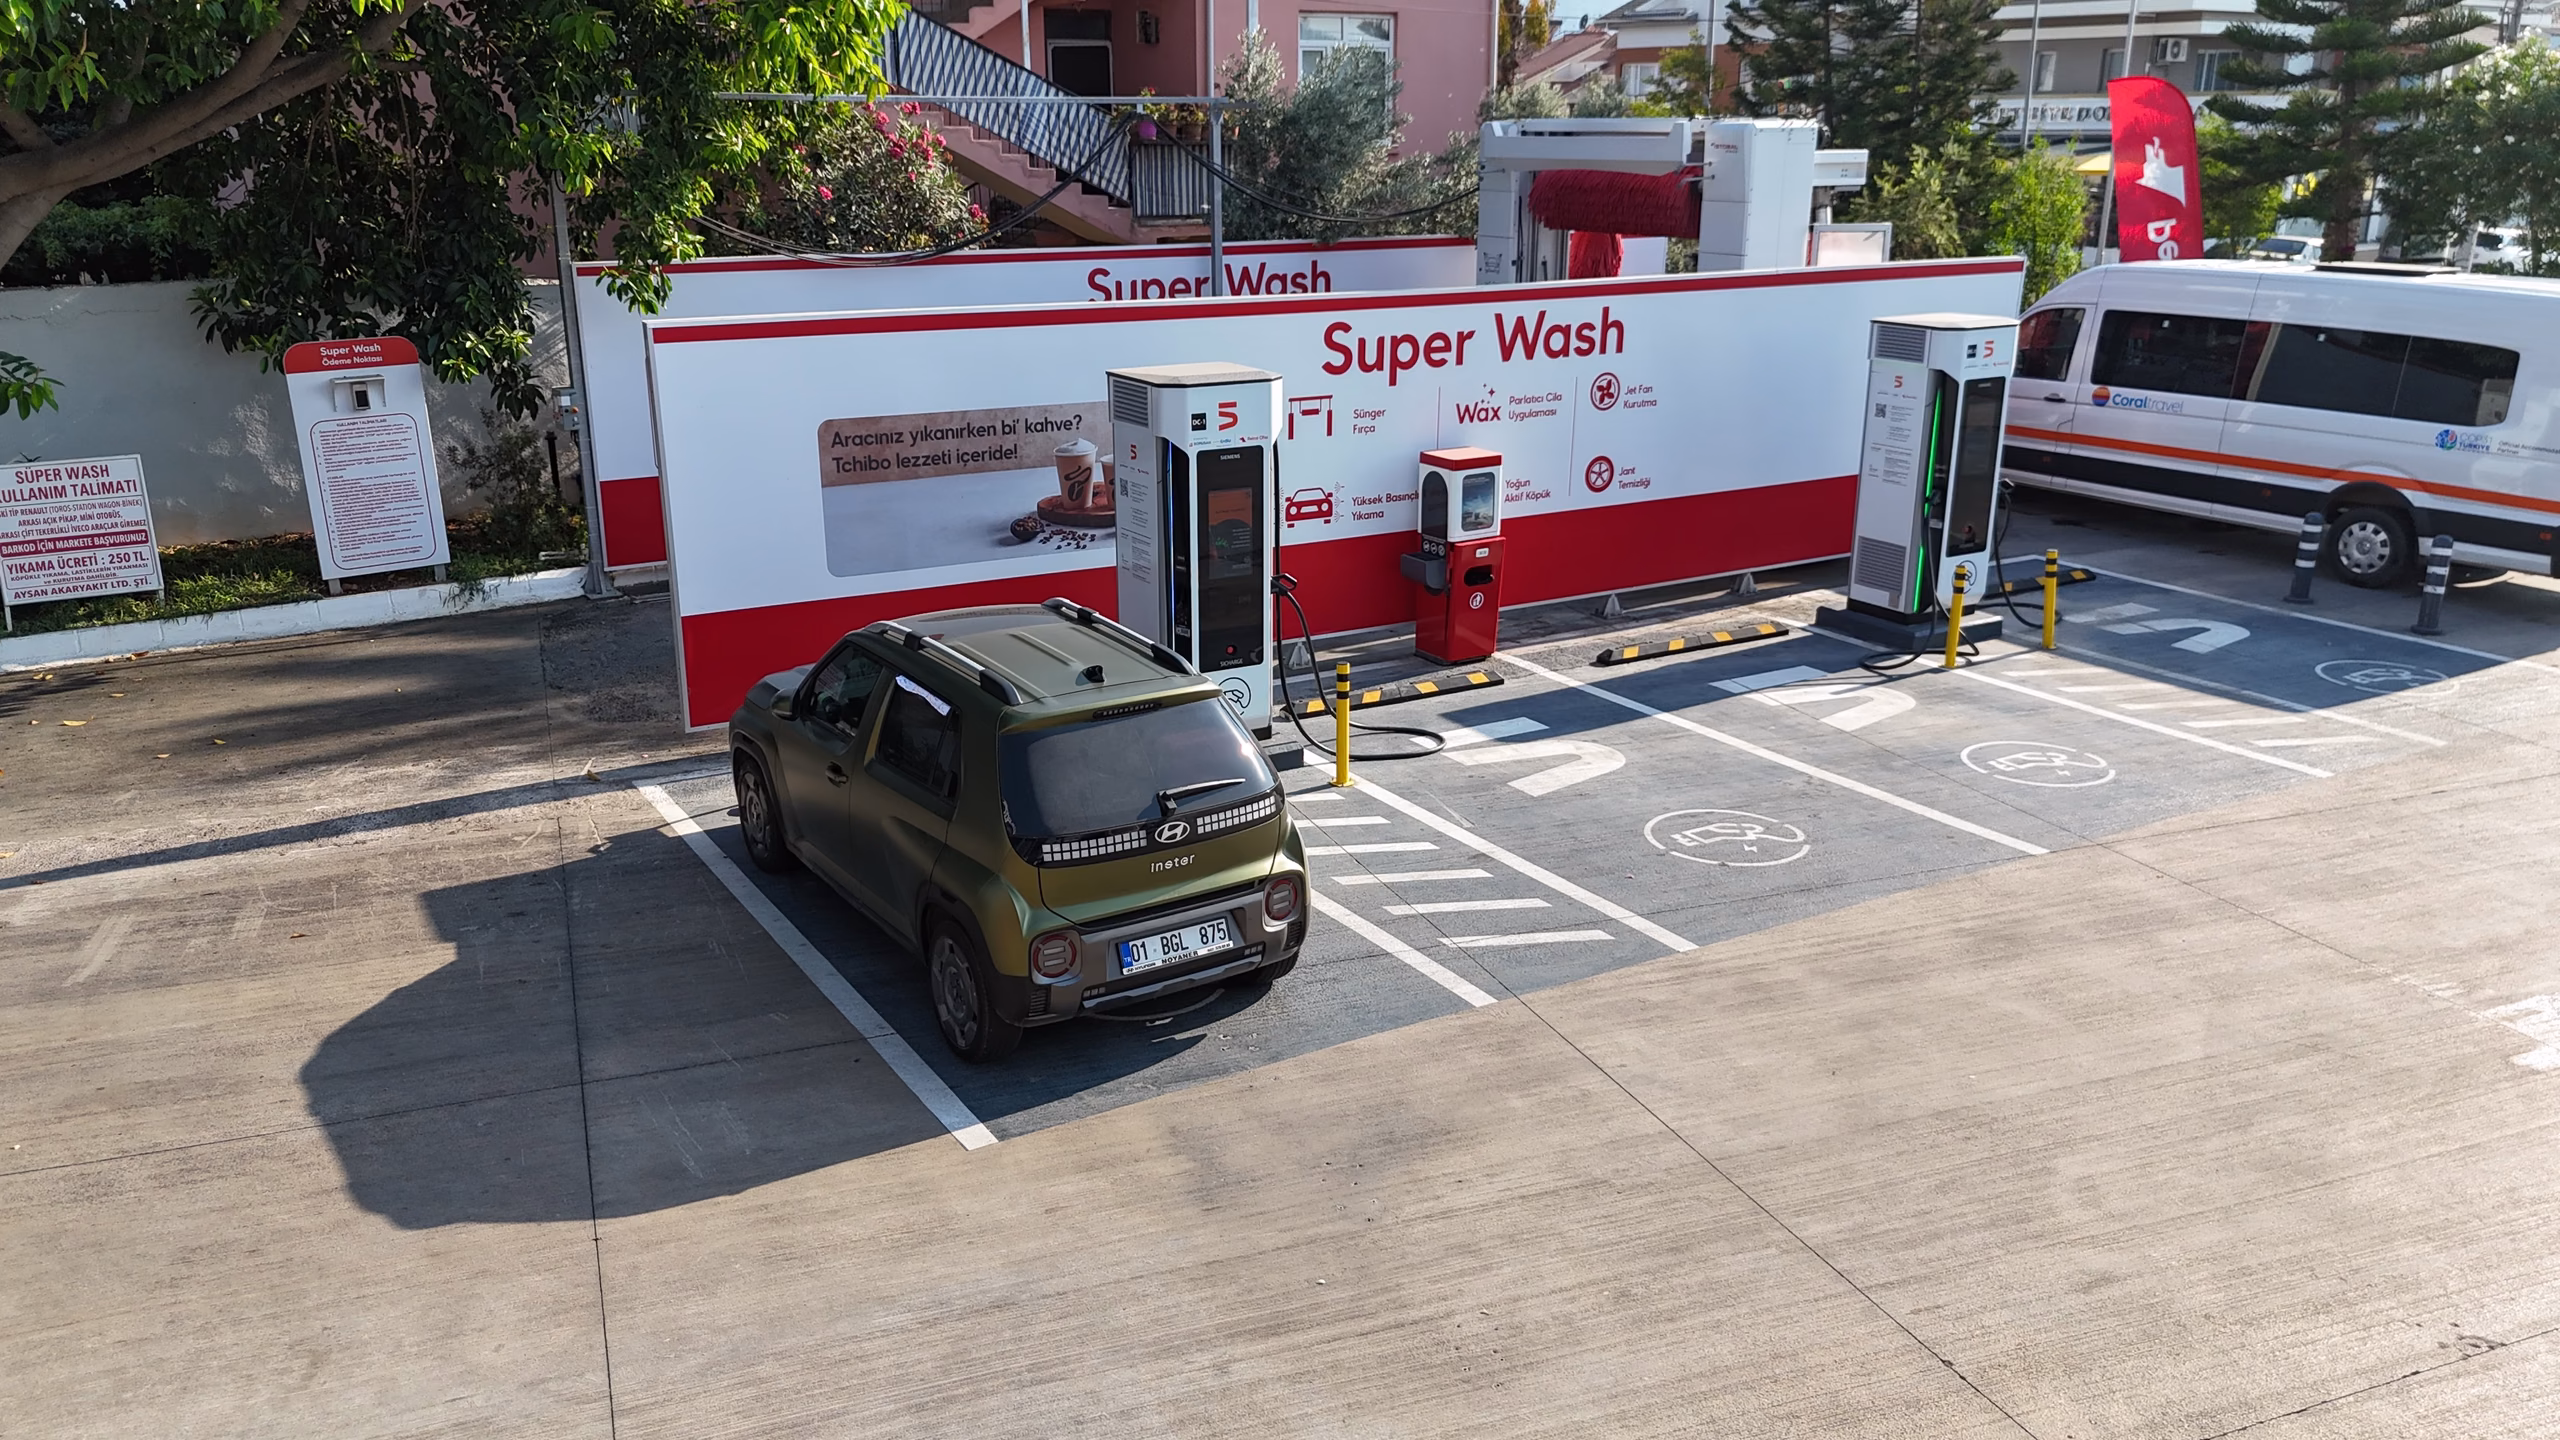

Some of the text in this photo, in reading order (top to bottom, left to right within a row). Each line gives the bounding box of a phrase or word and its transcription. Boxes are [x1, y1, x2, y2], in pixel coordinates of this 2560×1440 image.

[1224, 260, 1331, 296] Wash
[319, 343, 381, 357] Super Wash
[1322, 306, 1624, 386] Super Wash
[321, 357, 352, 366] Ödeme
[1624, 385, 1653, 395] Jet Fan
[1509, 392, 1563, 406] Parlatıcı Cila
[1623, 399, 1657, 409] Kurutma
[1353, 408, 1386, 420] Sünger
[1456, 402, 1502, 424] Wax
[1508, 408, 1557, 422] Uygulaması
[831, 430, 904, 449] Aracınız
[909, 424, 996, 448] yıkanırken
[1025, 414, 1082, 433] kahve?
[1353, 424, 1375, 435] Fırça
[831, 444, 1018, 474] Tchibo lezzeti içeride!
[15, 464, 109, 484] SÜPER WASH
[1618, 467, 1636, 476] Jant
[1505, 479, 1531, 491] Yoğun
[1618, 477, 1650, 490] Temizliği
[0, 479, 137, 504] ULLANIM TALİMATI
[1504, 489, 1551, 503] Aktif Köpük
[9, 508, 19, 517] TİP
[20, 507, 48, 516] RENAULT
[49, 503, 97, 515] (TOROS-STATION
[97, 498, 142, 509] WAGON-BİNEK)
[1352, 494, 1383, 507] Yüksek
[18, 518, 41, 527] ARKASI
[42, 516, 58, 526] AÇIK
[59, 514, 79, 523] PİKAP,
[80, 511, 95, 520] MİNİ
[1351, 510, 1384, 521] Yıkama
[21, 528, 35, 539] ÇİFT
[35, 524, 70, 536] TEKERLİKLİ
[71, 524, 90, 532] İVECO
[91, 522, 119, 531] ARAÇLAR
[120, 519, 147, 529] GİREMEZ
[1, 532, 147, 554] BARKOD İÇİN MARKETE BAŞVURUNUZ
[6, 560, 55, 575] YIKAMA
[57, 552, 98, 570] ÜCRETİ
[108, 552, 131, 565] 250
[132, 551, 149, 562] TL.
[11, 573, 41, 581] KÖPÜKLE
[71, 566, 111, 575] LASTİKLERİN
[112, 563, 149, 571] YIKANMASI
[53, 575, 85, 583] KURUTMA
[14, 575, 152, 600] AYSAN AKARYAKIT LTD. ŞTİ.
[1131, 921, 1227, 962] 01 BGL 875
[1162, 950, 1198, 964] NOYANER
